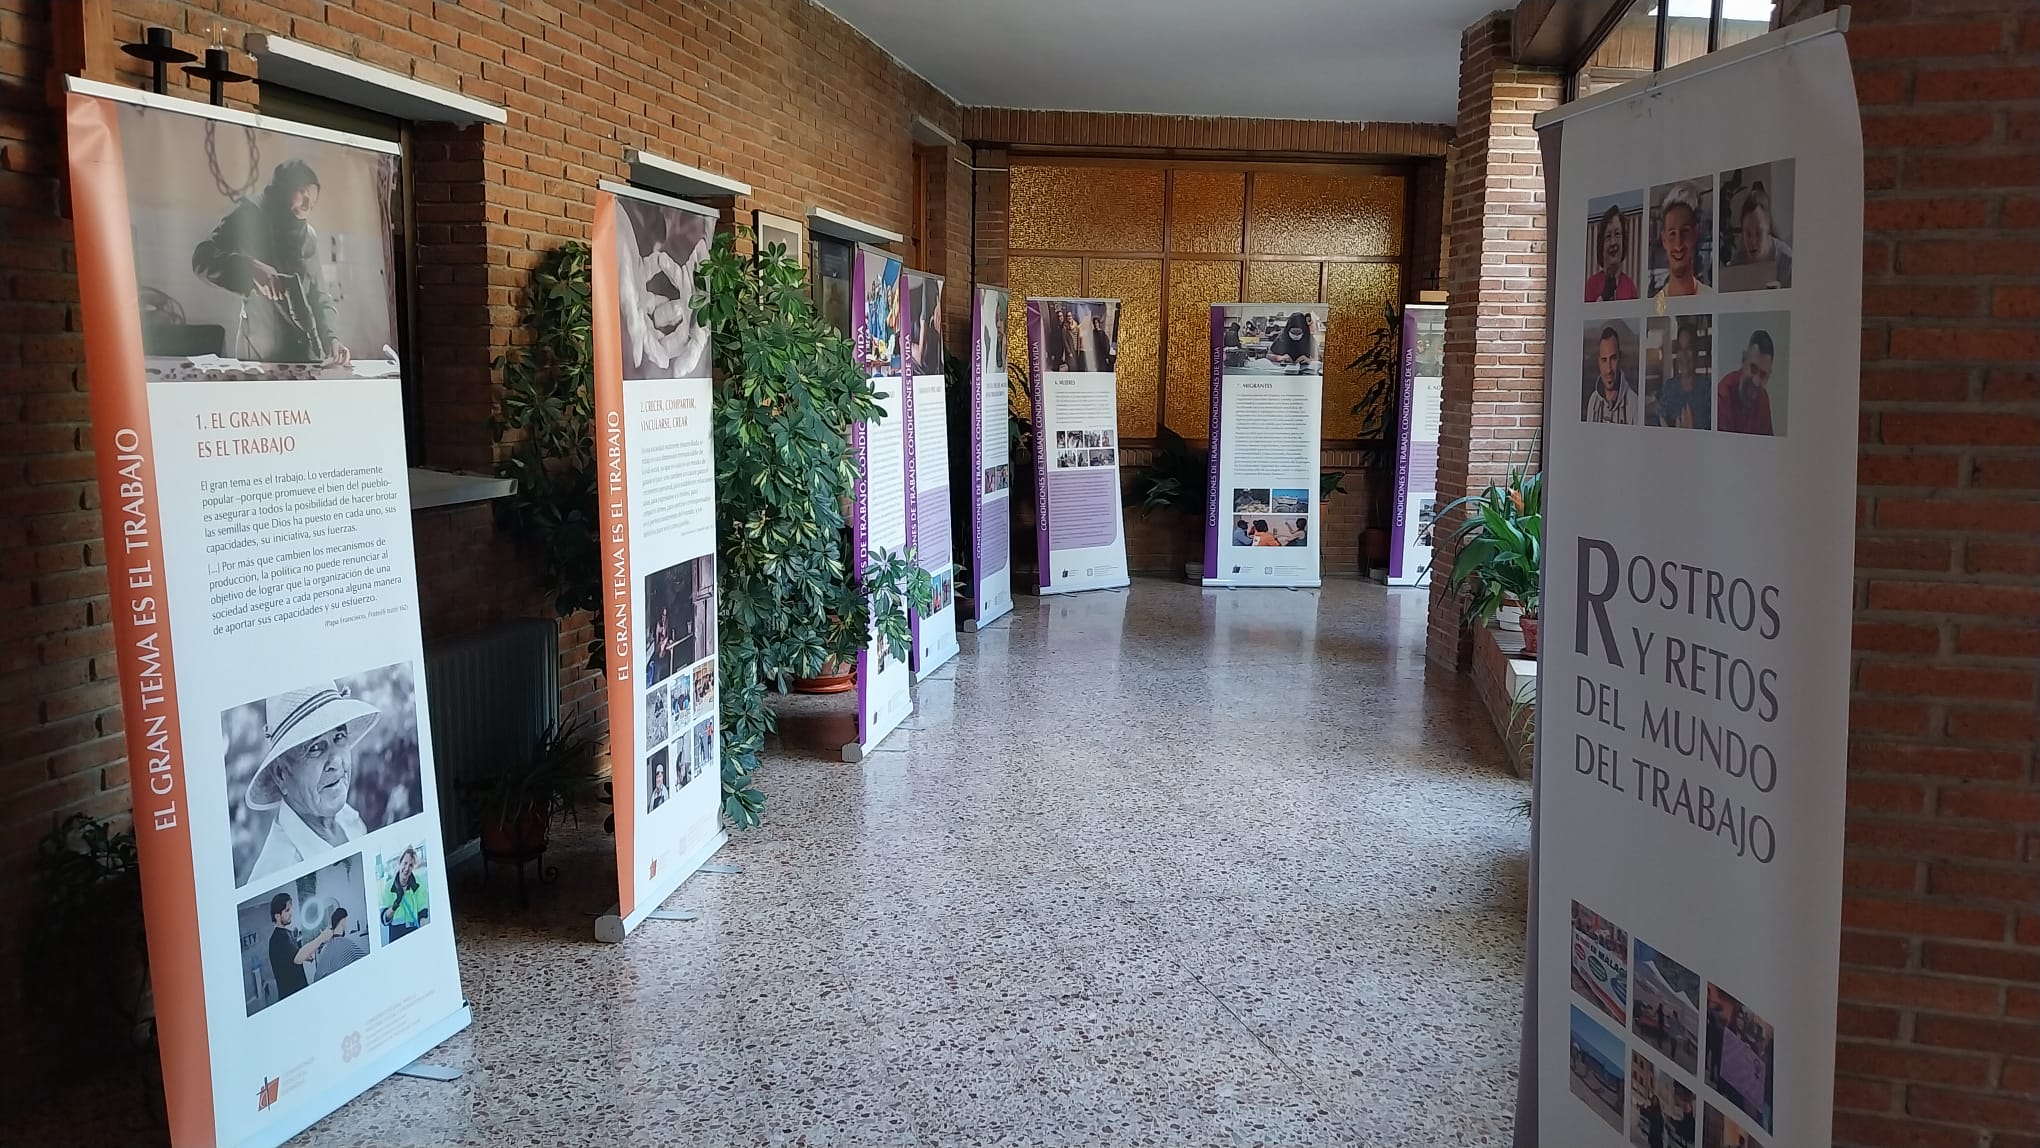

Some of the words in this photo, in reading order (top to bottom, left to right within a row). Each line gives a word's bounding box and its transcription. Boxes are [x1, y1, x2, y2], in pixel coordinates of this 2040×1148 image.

[1032, 341, 1040, 360] VIDA
[1405, 348, 1413, 368] VIDA
[905, 362, 912, 377] DE
[1033, 361, 1040, 372] DE
[1213, 366, 1220, 376] DE
[1405, 368, 1412, 377] DE
[1034, 373, 1043, 428] CONDICIONES
[1211, 377, 1220, 429] CONDICIONES
[1401, 379, 1410, 430] CONDICIONES
[195, 414, 207, 430] 1.
[211, 412, 225, 429] EL
[229, 411, 271, 428] GRAN
[274, 409, 311, 426] TEMA
[906, 379, 914, 455] CONDICIONES
[198, 441, 212, 458] ES
[216, 440, 230, 457] EL
[232, 436, 295, 455] TRABAJO
[607, 411, 622, 495] TRABAJO
[1036, 429, 1044, 464] TRABAJO,
[1211, 430, 1219, 462] TRABAJO,
[1400, 431, 1409, 463] TRABAJO,
[201, 481, 207, 490] El
[210, 481, 227, 493] gran
[230, 479, 250, 488] tema
[265, 475, 272, 484] el
[275, 473, 305, 483] trabajo.
[308, 472, 317, 480] Lo
[319, 466, 382, 479] verdaderamente
[908, 457, 916, 505] TRABAJO,
[1038, 464, 1045, 476] DE
[1210, 463, 1217, 474] DE
[1399, 466, 1406, 475] DE
[115, 428, 149, 554] TRABAJO
[202, 494, 233, 509] popular
[275, 487, 316, 501] promueve
[318, 484, 324, 493] el
[327, 483, 344, 492] bien
[347, 480, 358, 490] del
[1038, 477, 1047, 531] CONDICIONES
[1209, 475, 1217, 527] CONDICIONES
[1396, 475, 1406, 527] CONDICIONES
[205, 528, 215, 537] las
[218, 523, 250, 535] semillas
[253, 522, 269, 533] que
[272, 518, 290, 528] Dios
[293, 516, 302, 525] ha
[305, 514, 331, 526] puesto
[333, 512, 343, 520] en
[346, 508, 363, 518] cada
[215, 509, 250, 522] asegurar
[259, 505, 283, 515] todos
[286, 503, 292, 511] la
[295, 497, 337, 513] posibilidad
[340, 496, 349, 504] de
[352, 495, 373, 503] hacer
[376, 492, 396, 501] brotar
[611, 499, 622, 518] EL
[911, 507, 917, 521] DE
[206, 537, 258, 555] capacidades,
[273, 531, 311, 543] iniciativa,
[312, 529, 325, 537] sus
[328, 525, 357, 534] fuerzas.
[611, 523, 624, 543] ES
[222, 562, 235, 571] Por
[257, 556, 273, 567] que
[276, 549, 310, 562] cambien
[313, 548, 324, 556] los
[326, 540, 374, 554] mecanismos
[376, 537, 386, 546] de
[262, 570, 268, 579] la
[316, 560, 340, 572] puede
[342, 553, 379, 565] renunciar
[382, 550, 388, 559] al
[860, 543, 867, 558] DE
[128, 560, 153, 588] EL
[211, 594, 243, 605] objetivo
[246, 587, 256, 597] de
[259, 585, 283, 596] lograr
[287, 582, 302, 592] que
[304, 578, 310, 586] la
[364, 567, 374, 575] de
[377, 565, 390, 573] una
[612, 547, 626, 599] TEMA
[131, 596, 157, 626] ES
[212, 603, 248, 620] sociedad
[250, 600, 283, 612] asegure
[292, 592, 311, 603] cada
[313, 587, 344, 602] persona
[346, 583, 371, 594] alguna
[374, 577, 401, 587] manera
[1575, 536, 1781, 668] ROSTROS
[213, 625, 223, 635] de
[226, 620, 254, 634] aportar
[258, 616, 271, 625] sus
[274, 604, 323, 622] capacidades
[342, 595, 377, 607] esfuerzo.
[615, 603, 628, 656] GRAN
[135, 632, 165, 710] TEMA
[618, 661, 629, 681] EL
[1632, 627, 1654, 675] Y
[1665, 636, 1779, 722] RETOS
[1576, 675, 1626, 731] DEL
[1642, 700, 1777, 792] MUNDO
[144, 716, 173, 795] GRAN
[1575, 733, 1625, 792] DEL
[1632, 758, 1776, 864] TRABAJO
[153, 801, 177, 831] EL
